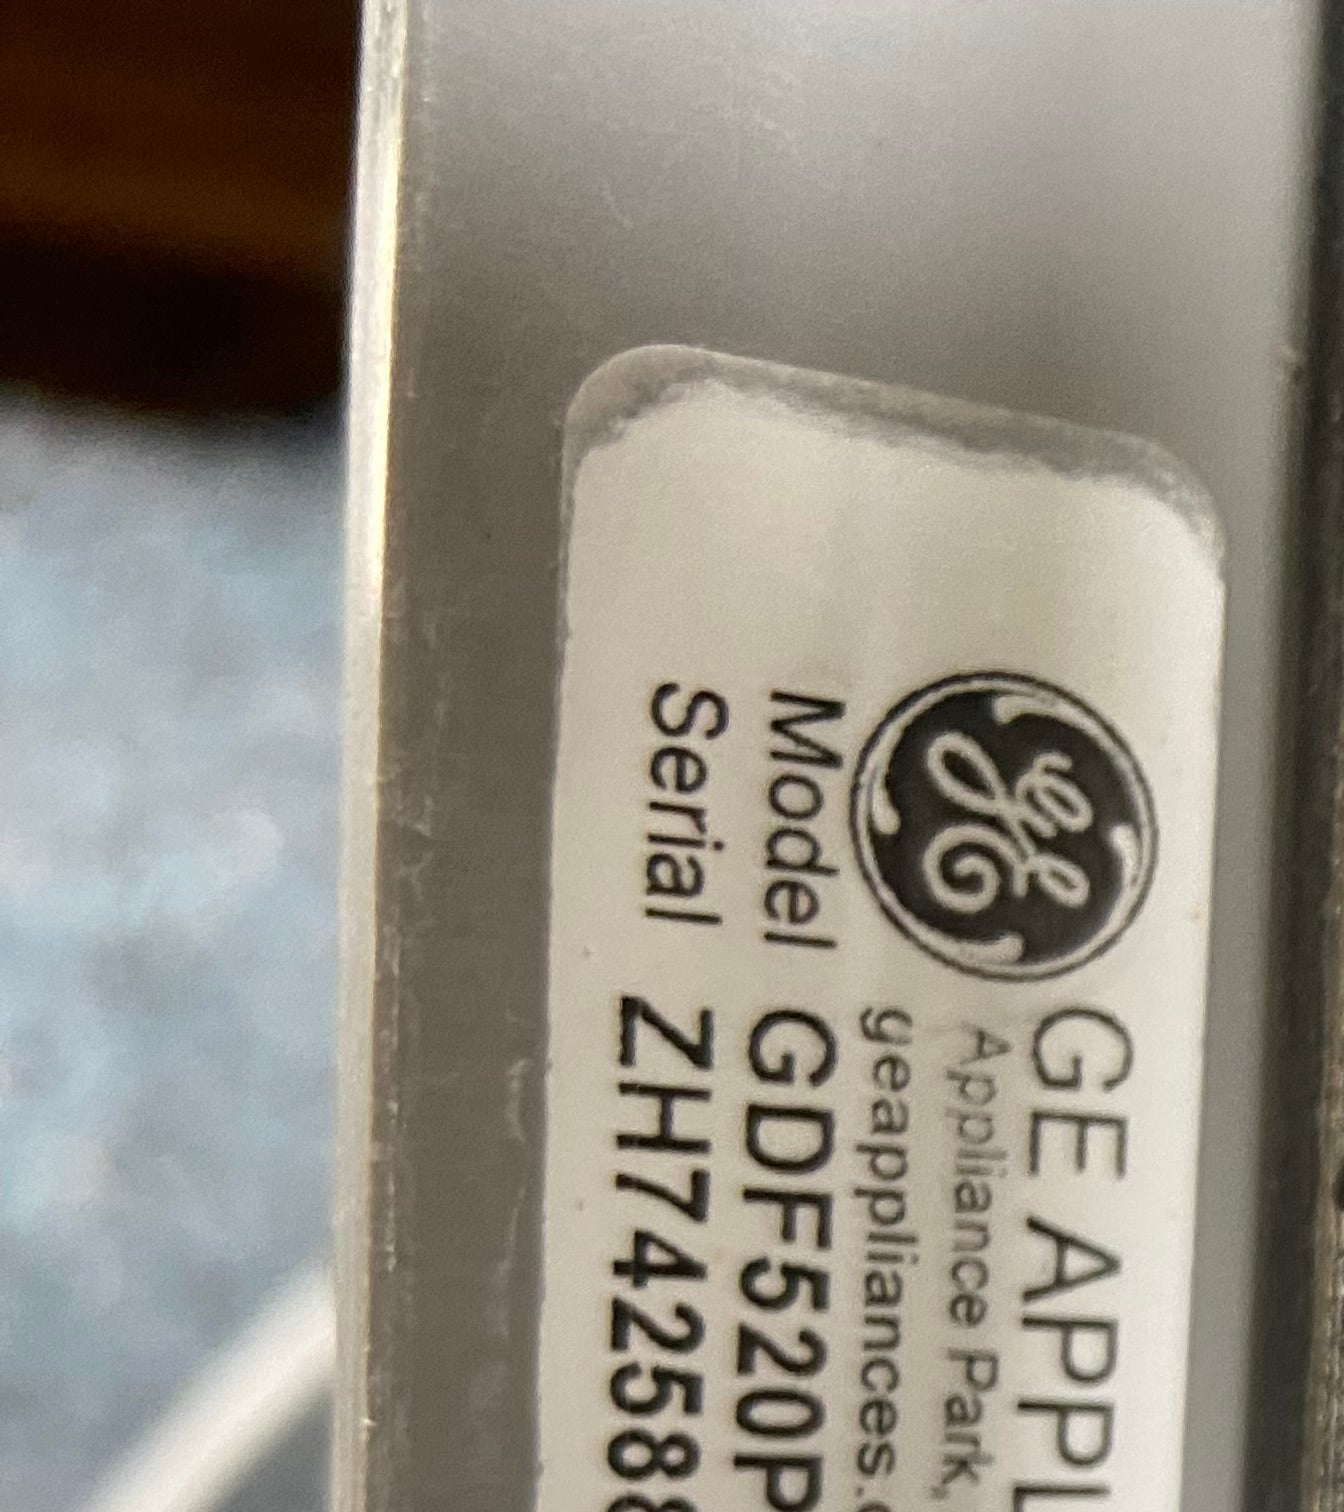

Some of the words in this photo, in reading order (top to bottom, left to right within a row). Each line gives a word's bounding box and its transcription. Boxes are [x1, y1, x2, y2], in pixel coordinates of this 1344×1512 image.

[645, 682, 730, 925] Serial
[763, 690, 847, 950] Model
[946, 1023, 1012, 1329] Appliance
[1029, 1006, 1135, 1180] GE
[932, 1346, 998, 1499] Park,
